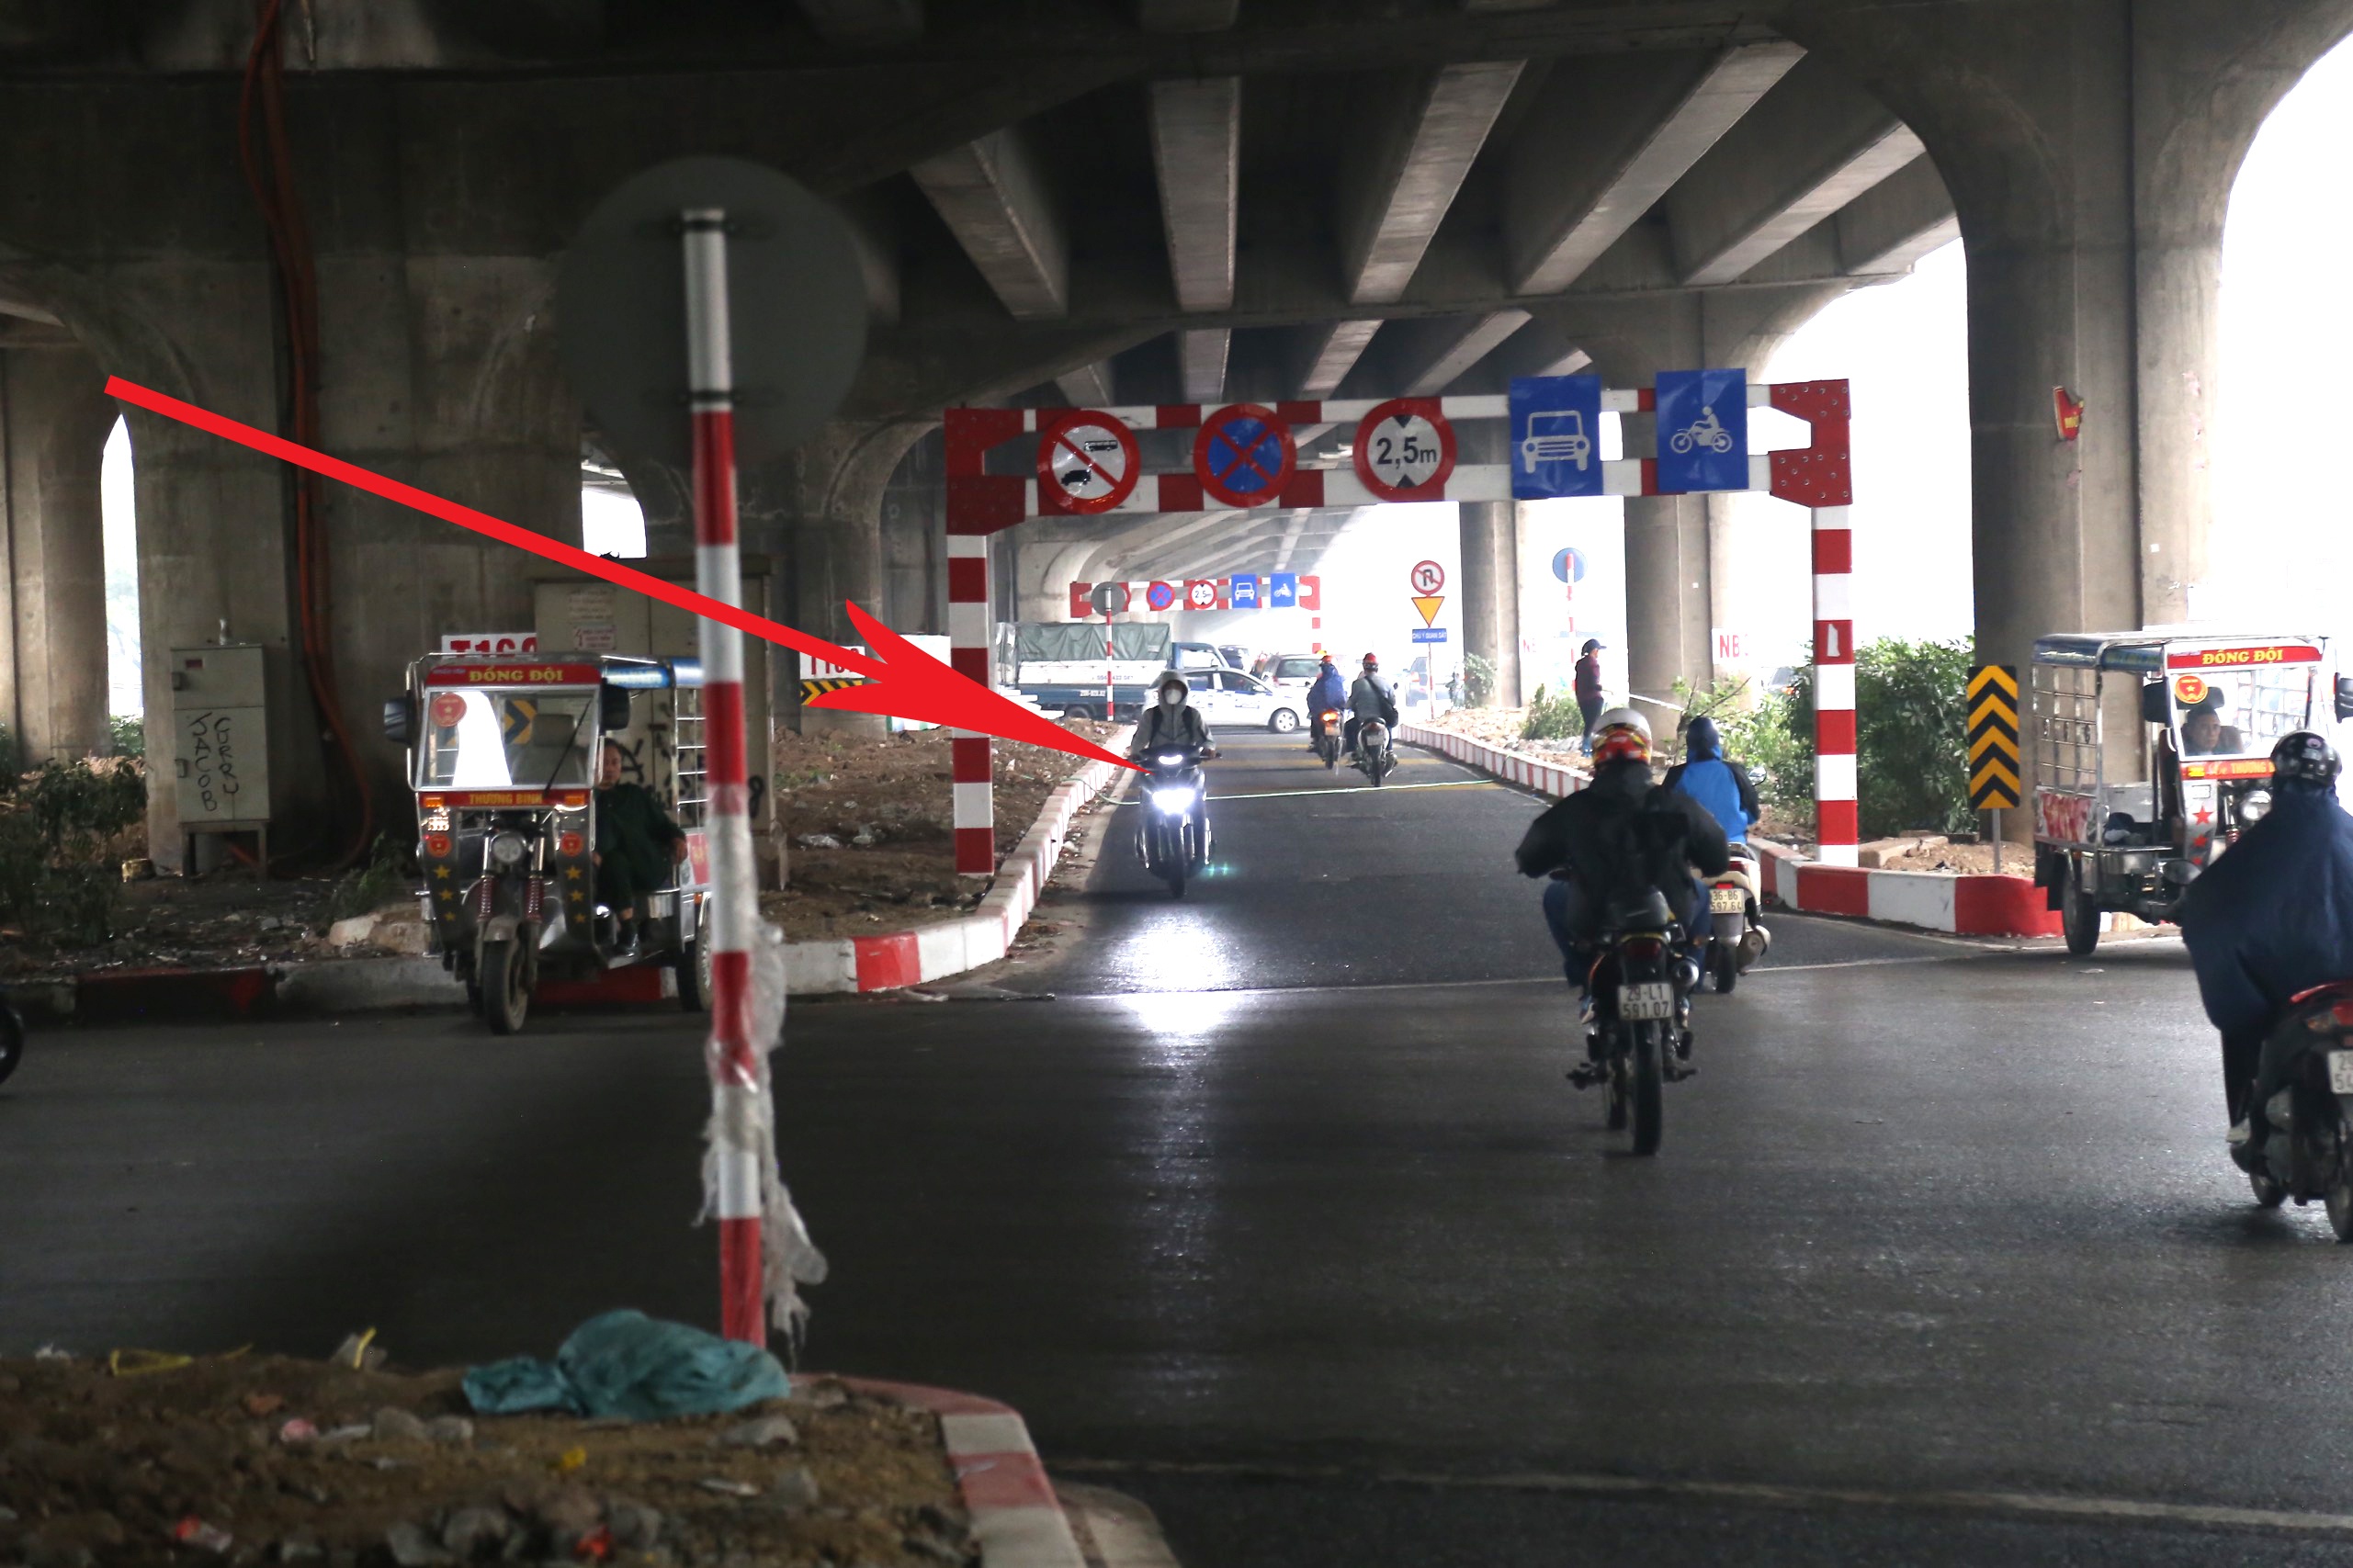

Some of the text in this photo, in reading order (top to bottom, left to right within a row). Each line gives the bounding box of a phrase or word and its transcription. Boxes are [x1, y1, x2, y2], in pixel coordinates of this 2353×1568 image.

[1376, 436, 1437, 469] 2,5m
[2254, 647, 2283, 664] ĐỘI
[529, 667, 563, 683] ĐỘI
[188, 712, 217, 811] JACOB
